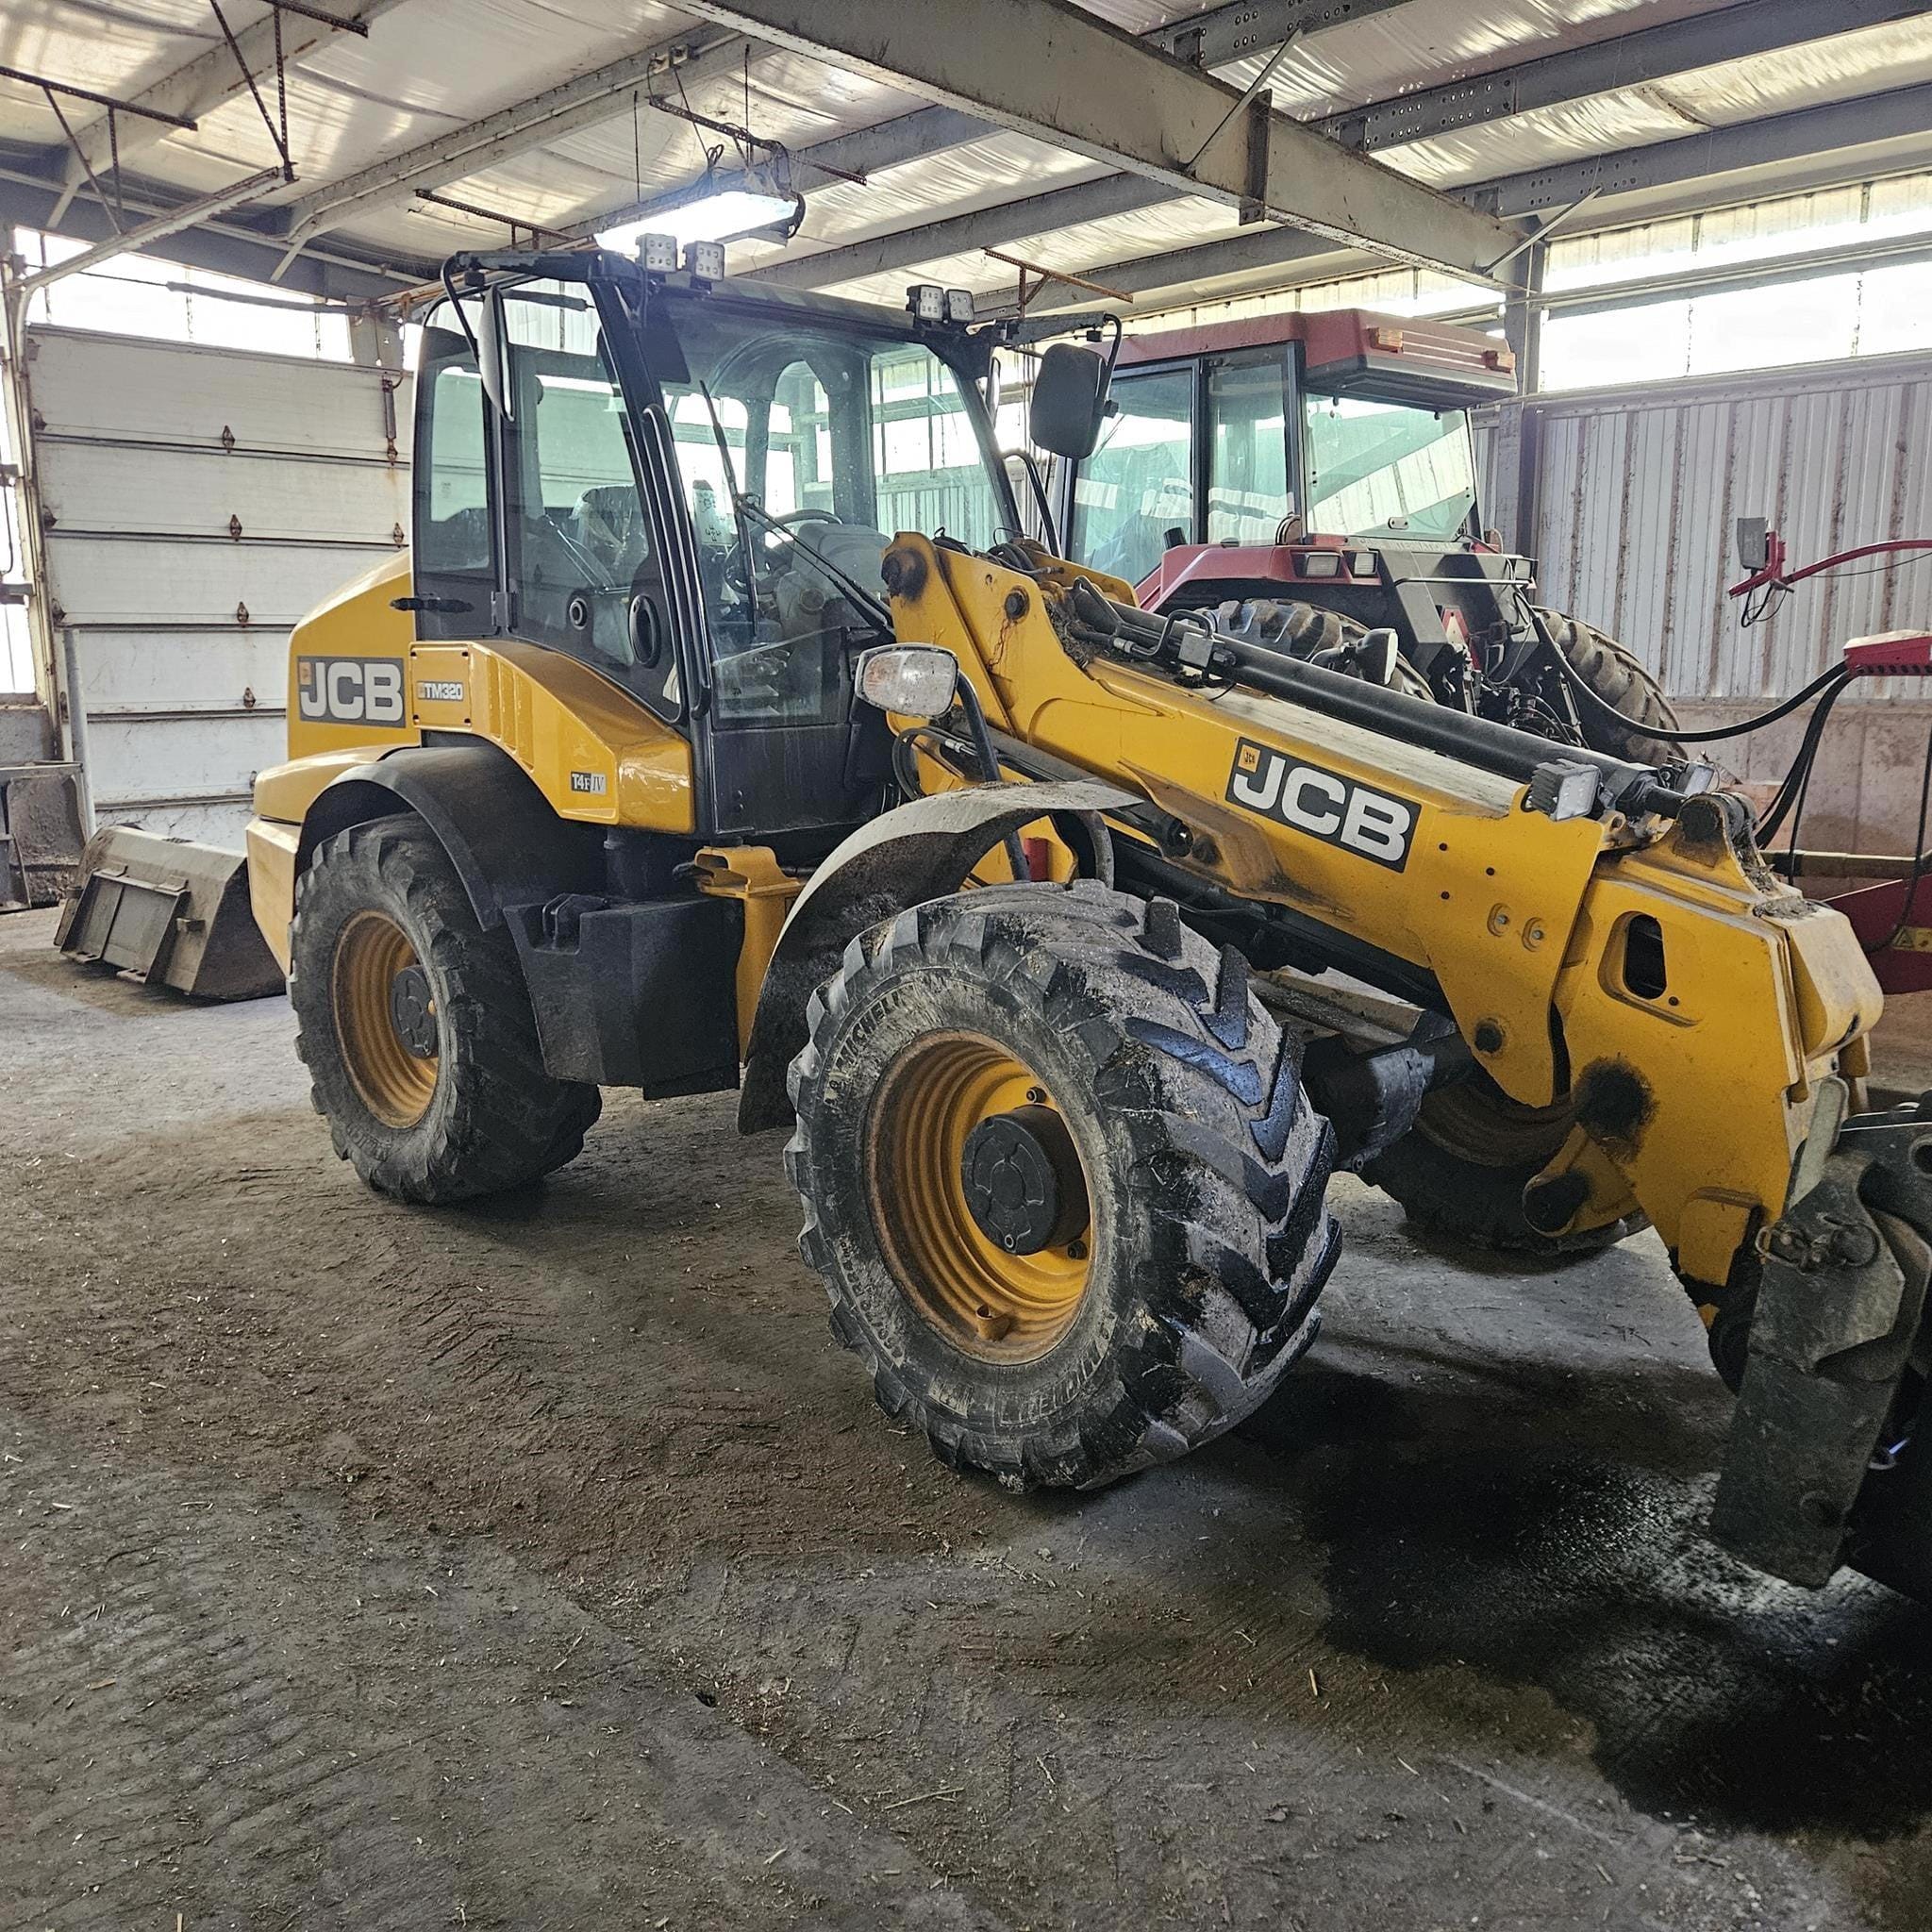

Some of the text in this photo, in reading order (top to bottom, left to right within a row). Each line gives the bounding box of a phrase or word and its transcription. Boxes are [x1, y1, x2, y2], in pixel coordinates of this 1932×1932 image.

[300, 662, 403, 721] JCB
[425, 683, 463, 699] TM320
[572, 773, 591, 791] T4F
[1233, 755, 1410, 861] JCB
[833, 984, 913, 1073] MICHELI
